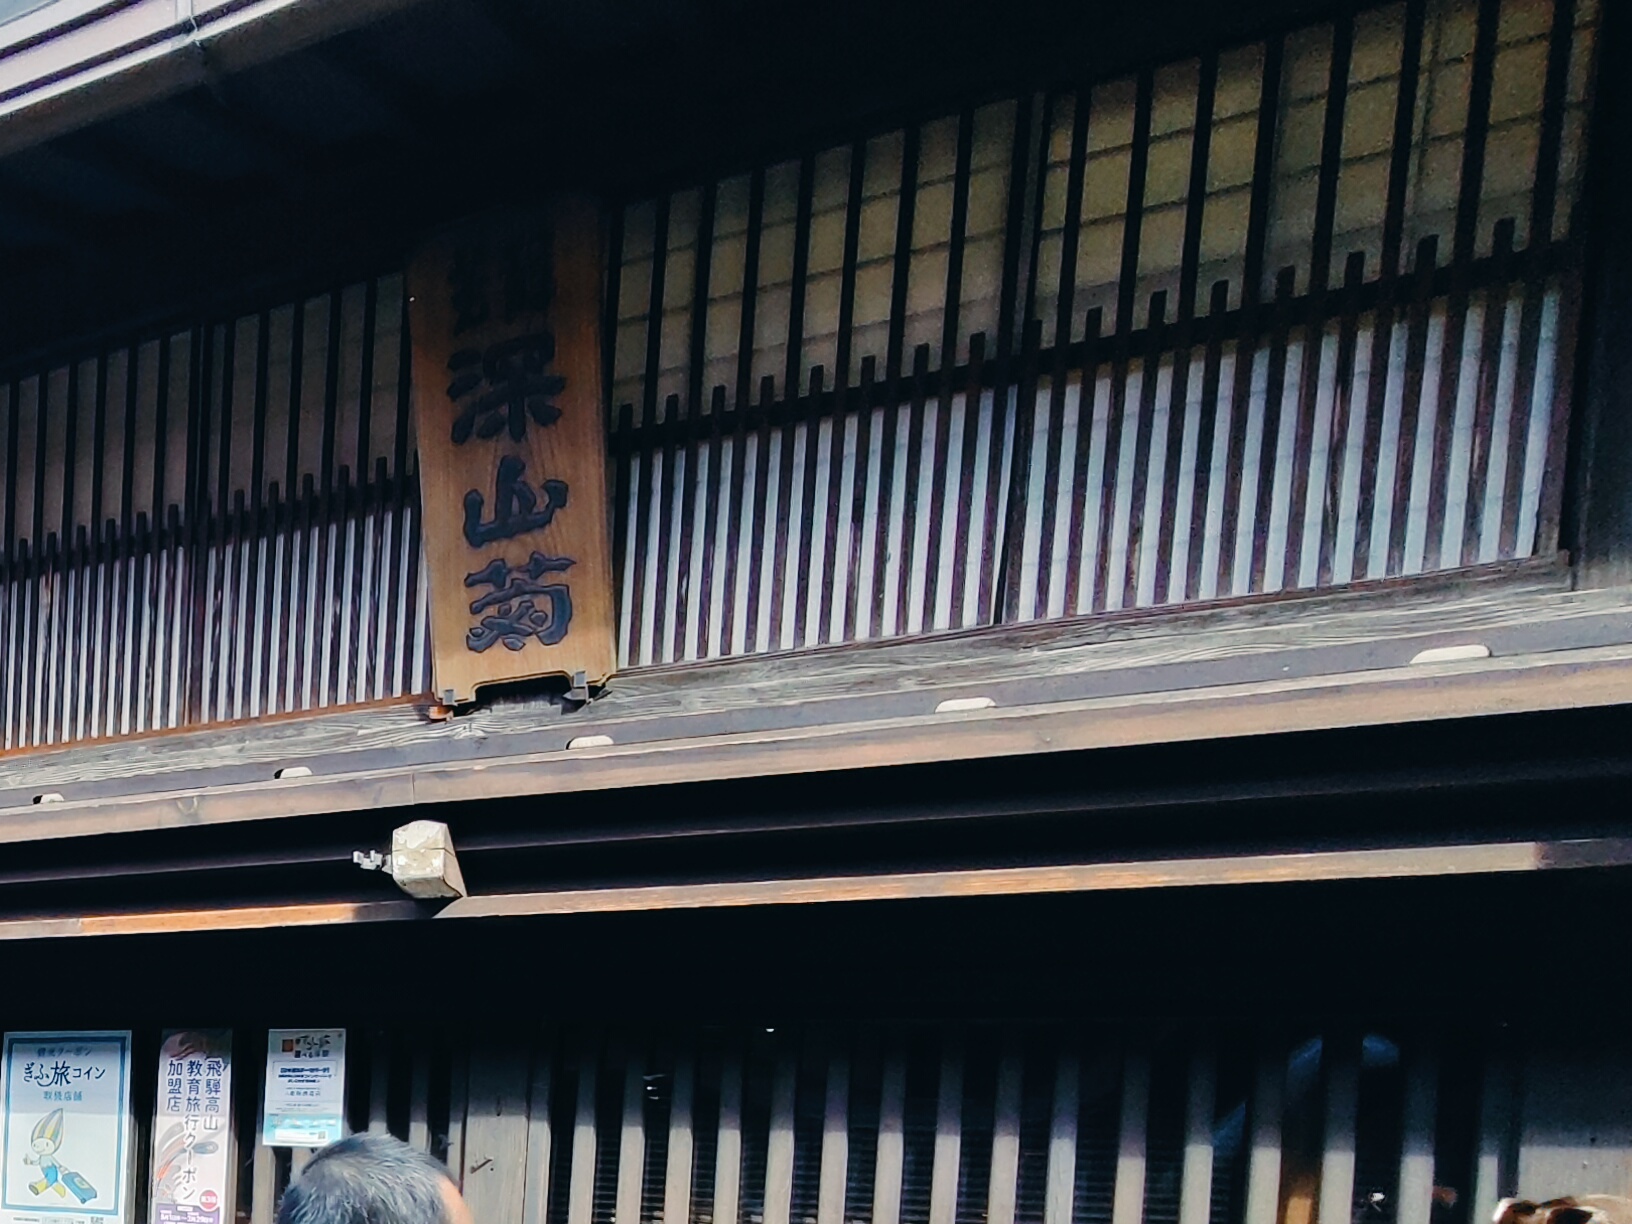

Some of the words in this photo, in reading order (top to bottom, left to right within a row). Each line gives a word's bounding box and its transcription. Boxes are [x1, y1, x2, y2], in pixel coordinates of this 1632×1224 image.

[23, 1060, 106, 1087] ぎふ旅コイン
[167, 1060, 183, 1113] 加盟店
[182, 1059, 202, 1200] 教育旅行クーポン
